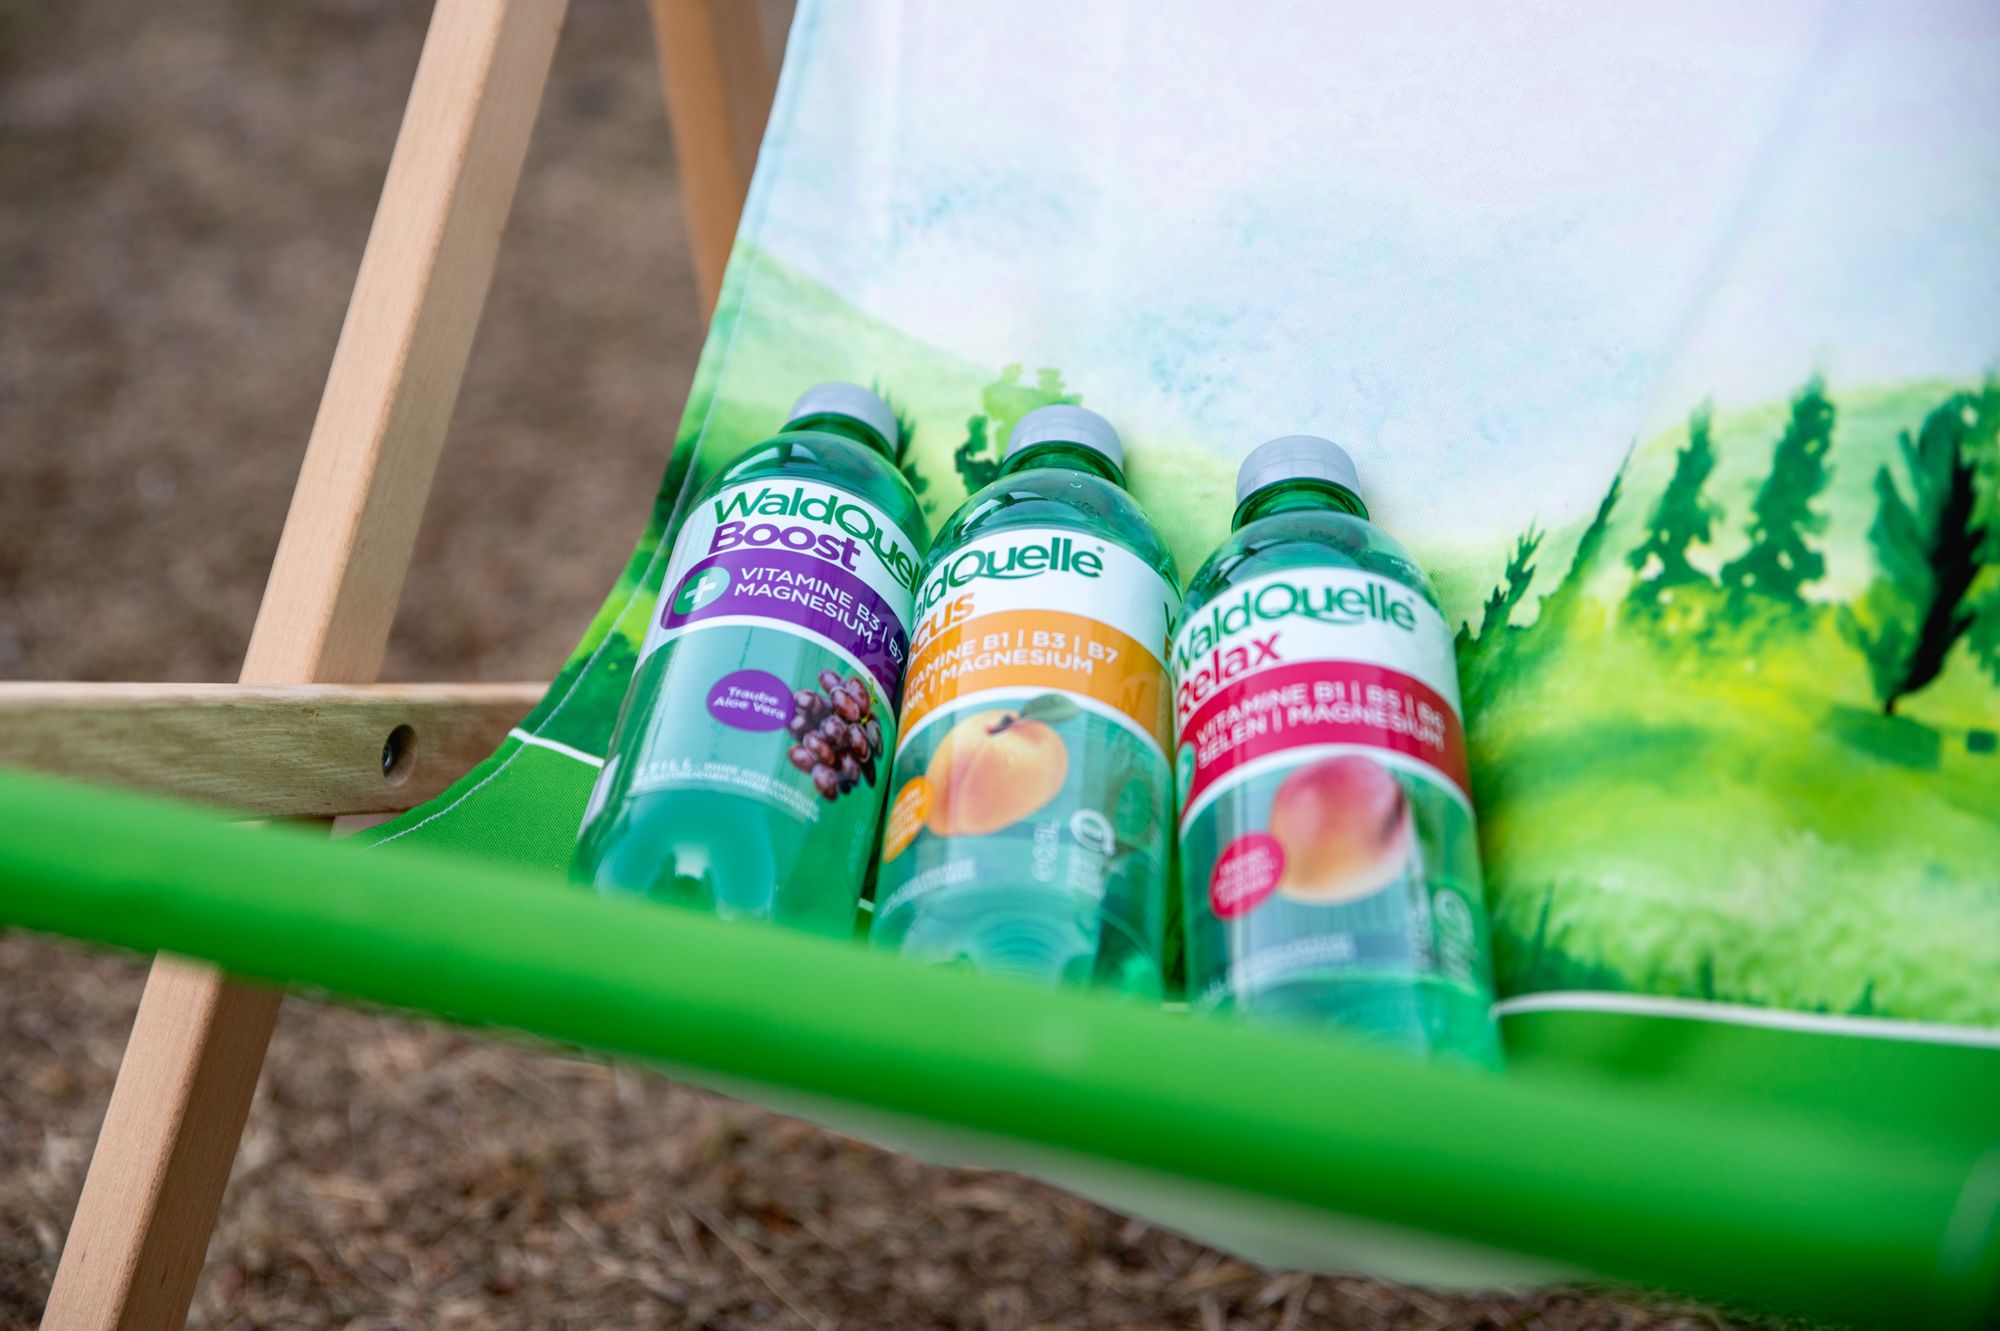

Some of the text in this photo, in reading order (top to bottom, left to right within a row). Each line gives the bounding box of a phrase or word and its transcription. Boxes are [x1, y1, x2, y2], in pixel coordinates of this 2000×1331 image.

[708, 521, 861, 572] Boost
[714, 488, 920, 595] WaldQuel
[741, 567, 853, 609] VITAMINE
[857, 603, 880, 631] B3
[912, 537, 1104, 626] aldQuelle
[734, 583, 873, 645] MAGNESIUM
[940, 648, 1093, 686] MAGNESIUM
[982, 632, 1009, 651] B1
[1032, 630, 1065, 649] B3
[1088, 641, 1118, 664] B7
[713, 696, 787, 721] Aloe Vera
[728, 686, 779, 706] Traube
[1196, 682, 1308, 748] VITAMINE
[1287, 702, 1445, 753] MAGNESIUM
